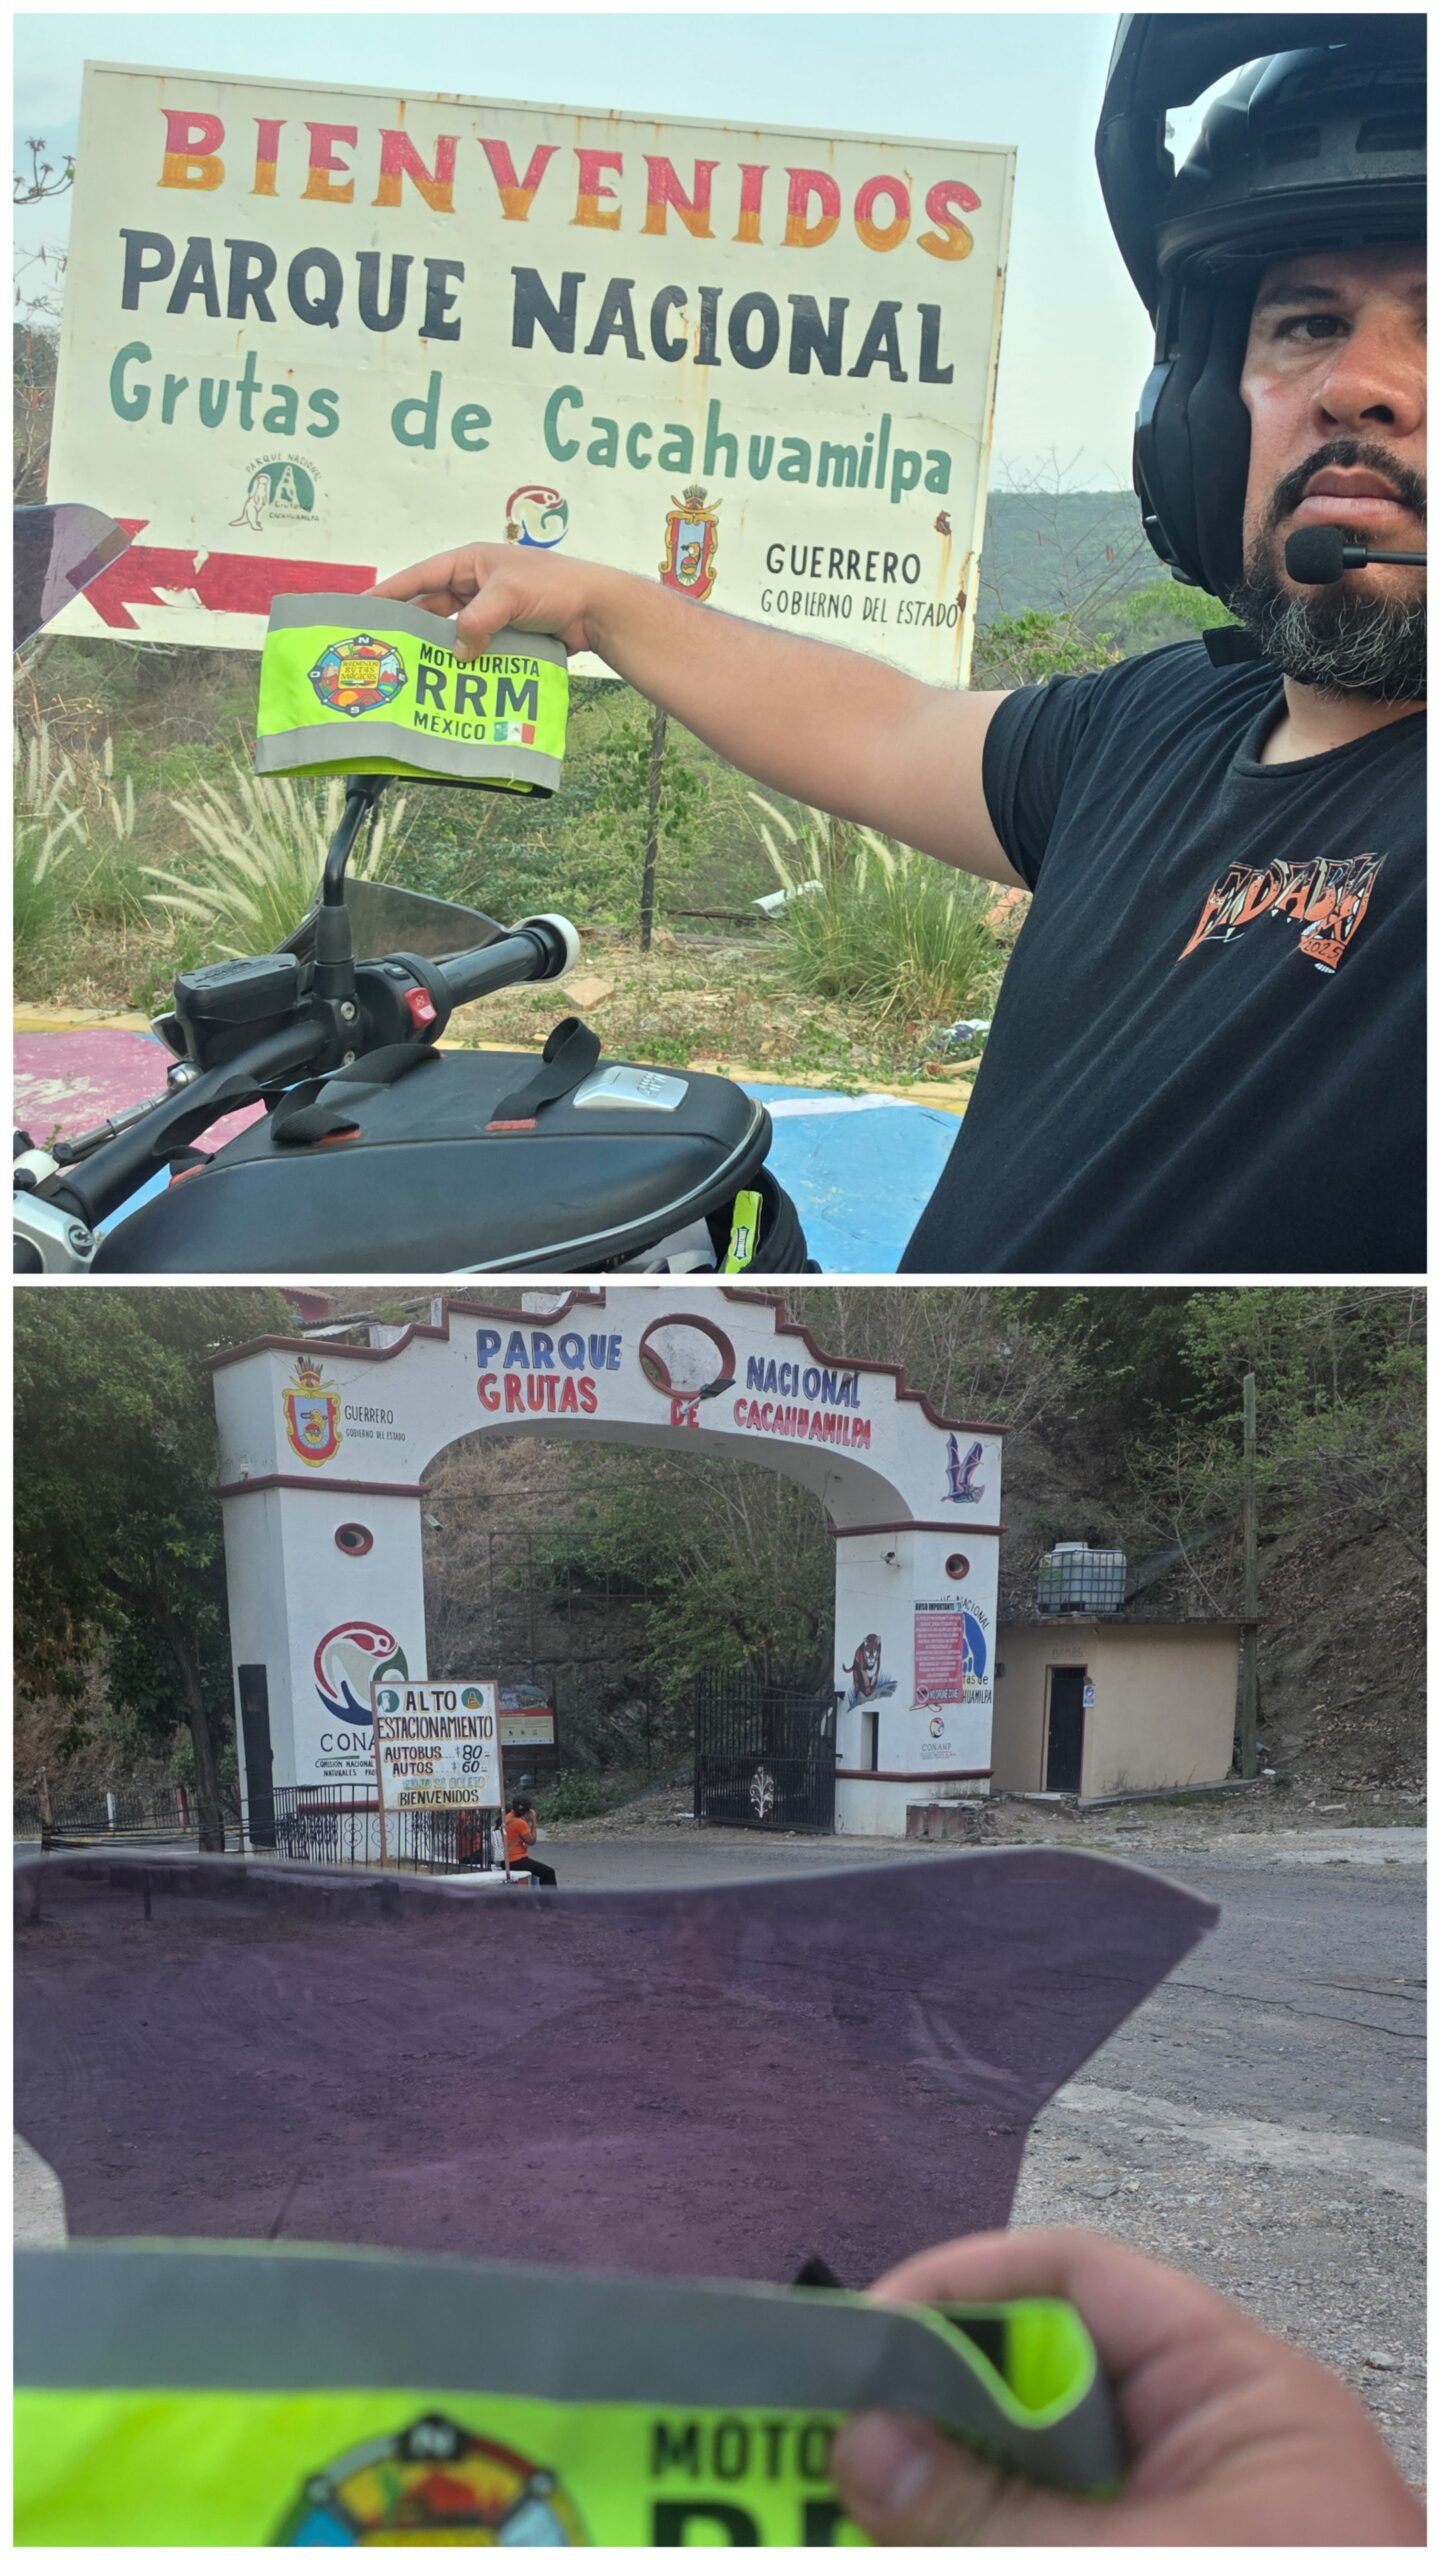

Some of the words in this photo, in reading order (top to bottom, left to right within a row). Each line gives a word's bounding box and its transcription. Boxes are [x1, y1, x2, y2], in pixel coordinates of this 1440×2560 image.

[157, 108, 982, 261] BIENVENIDOS
[119, 228, 465, 341] PARQUE
[511, 266, 955, 385] NACIONAL
[110, 341, 340, 438] Grutas
[391, 370, 492, 451] de
[544, 385, 952, 504] Cacahuamilpa
[766, 543, 921, 584] GUERRERO
[761, 589, 853, 619] GOBIERNO
[863, 596, 888, 623] DEL
[896, 600, 958, 628] ESTADO
[415, 664, 539, 721] RRM
[414, 710, 486, 740] MÉXICO
[475, 1329, 622, 1371] PARQUE
[746, 1355, 861, 1408] NACIONAL
[345, 1405, 394, 1424] GUERRERO
[477, 1373, 598, 1413] GRUTAS
[671, 1398, 700, 1428] DE
[733, 1398, 871, 1449] CACAHUAMILPA
[346, 1428, 373, 1439] GOBIERNO
[376, 1430, 385, 1440] DEL
[387, 1431, 406, 1441] ESTADO
[406, 1690, 457, 1711] ALTO
[377, 1716, 493, 1739] ESTACIONAMIENTO
[346, 1760, 373, 1768] NACIONAL
[385, 1746, 442, 1760] AUTOBUS
[393, 1761, 434, 1774] AUTOS
[400, 1789, 480, 1806] BIENVENIDOS
